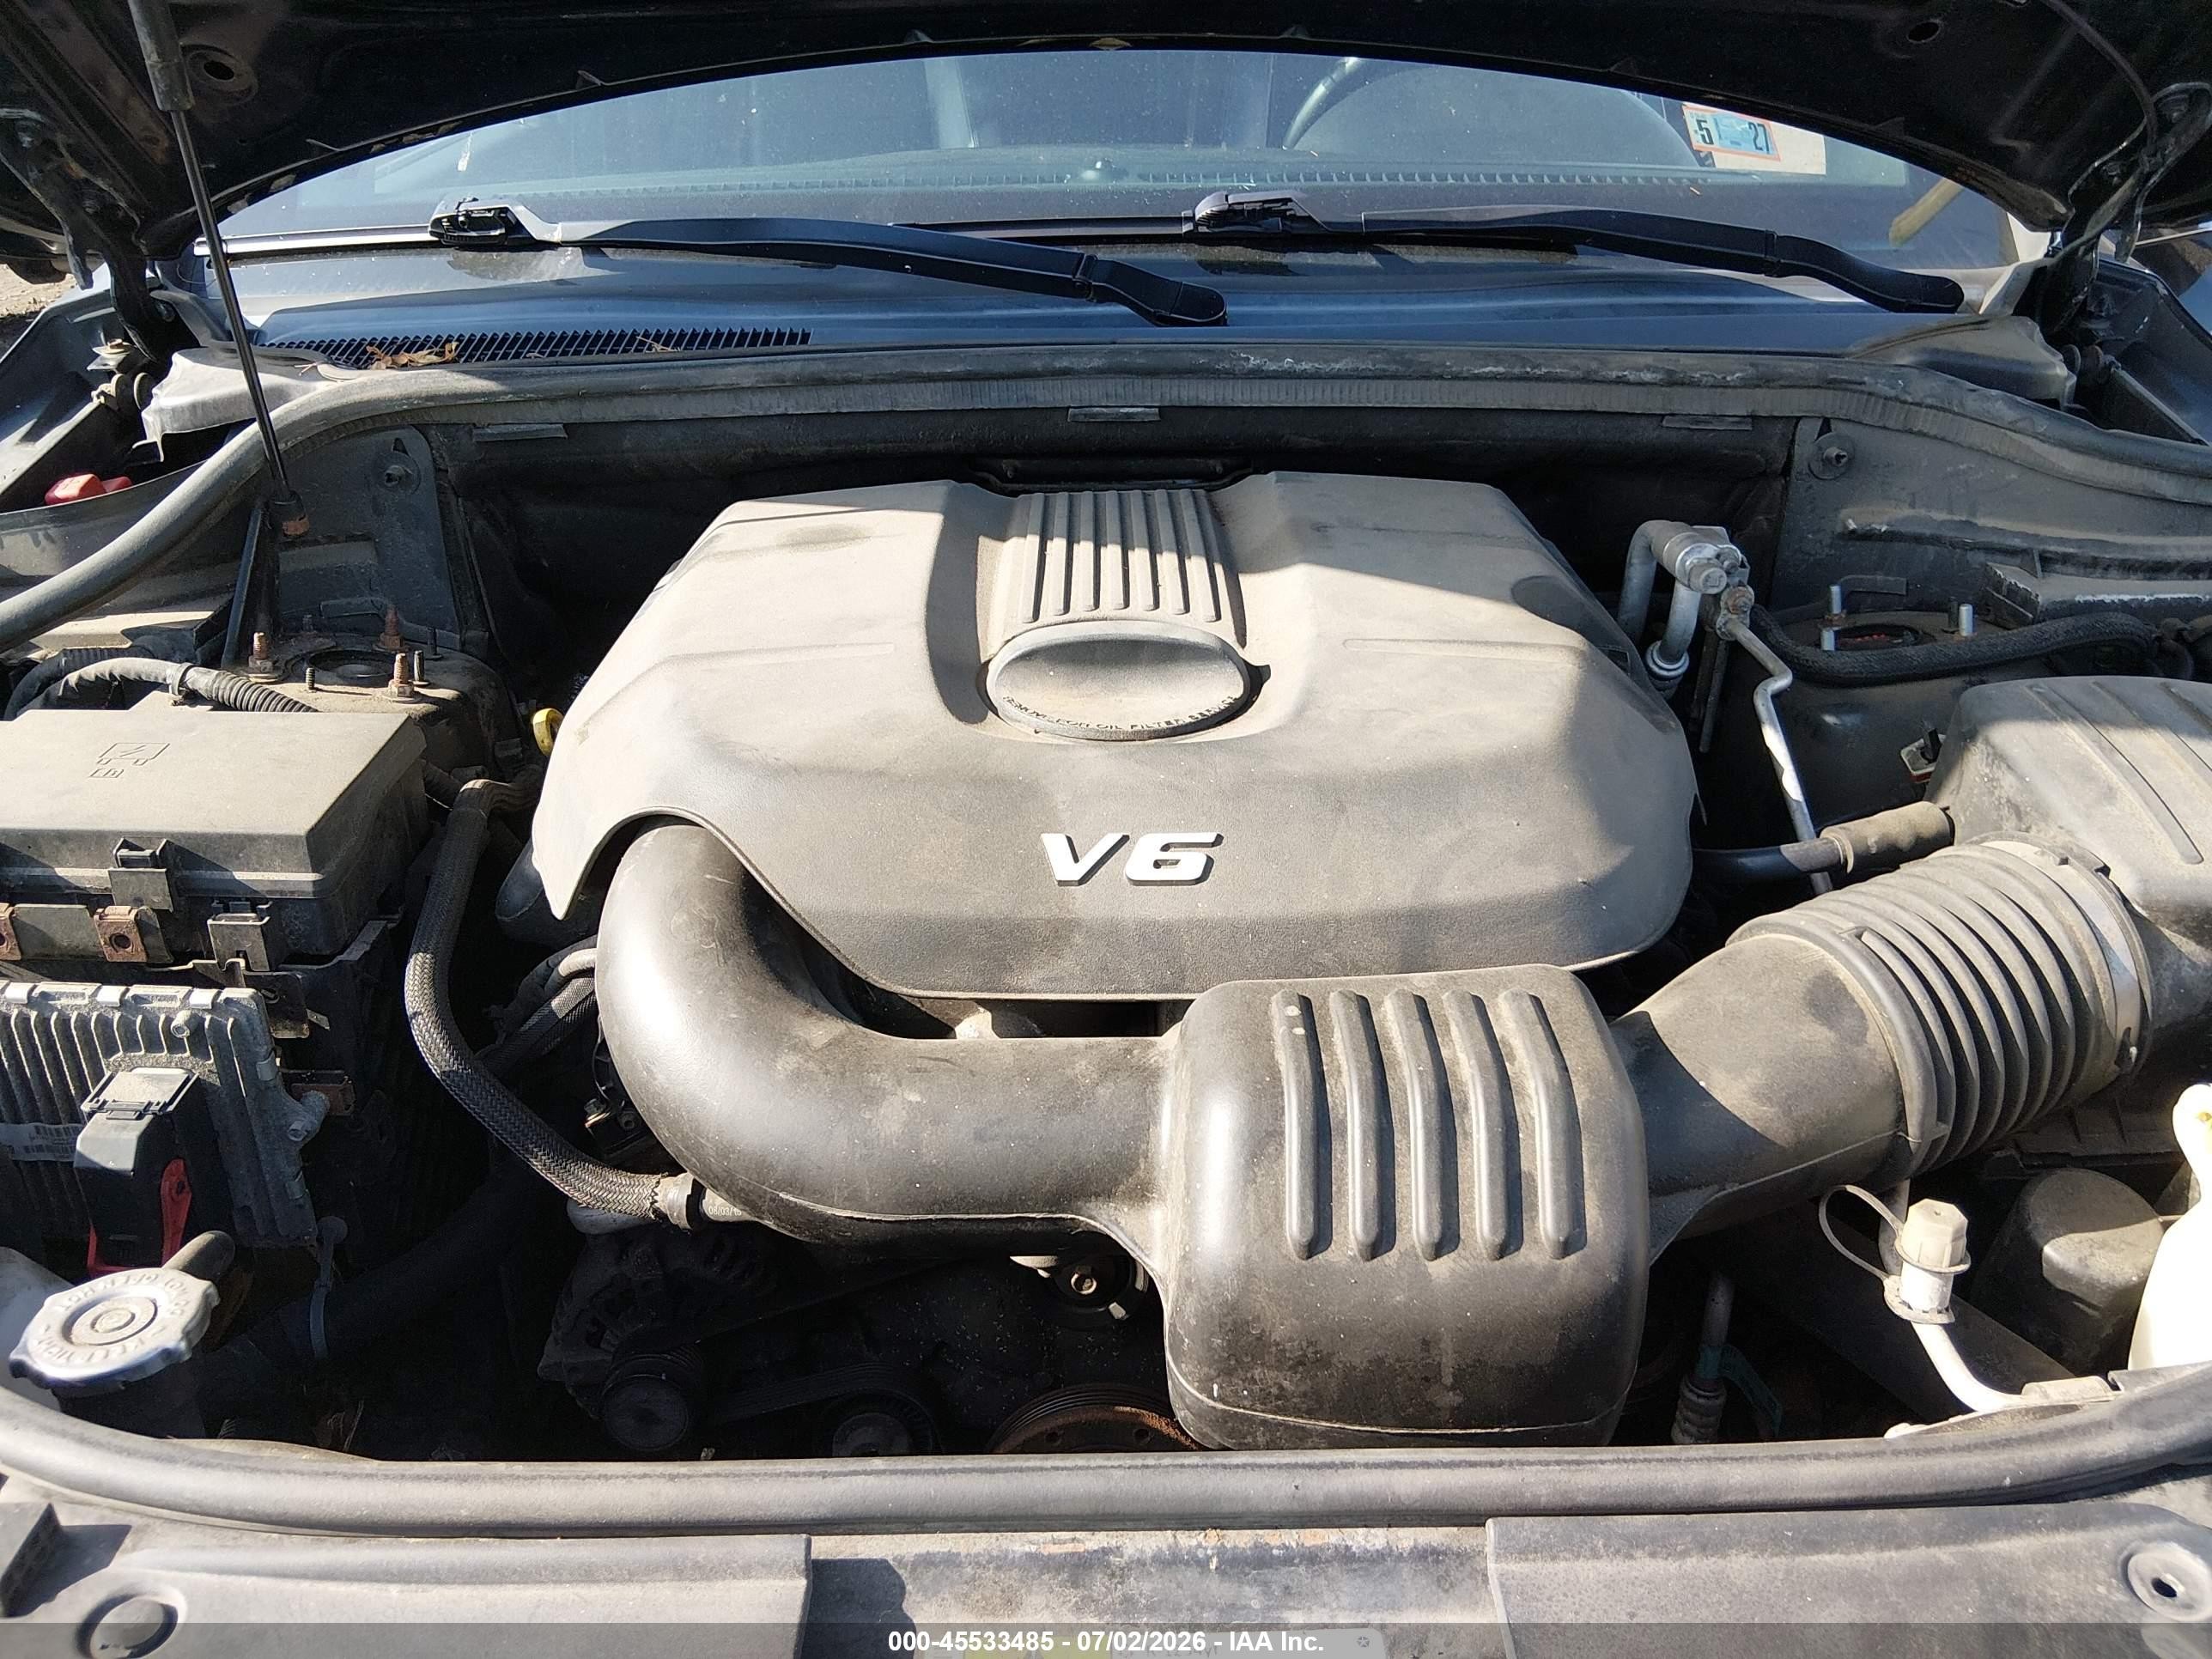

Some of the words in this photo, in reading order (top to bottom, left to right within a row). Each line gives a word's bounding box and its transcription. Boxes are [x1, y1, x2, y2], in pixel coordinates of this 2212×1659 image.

[1696, 118, 1714, 145] 5
[1747, 121, 1770, 155] 27
[1130, 720, 1187, 730] FILTER
[1041, 832, 1224, 886] V6
